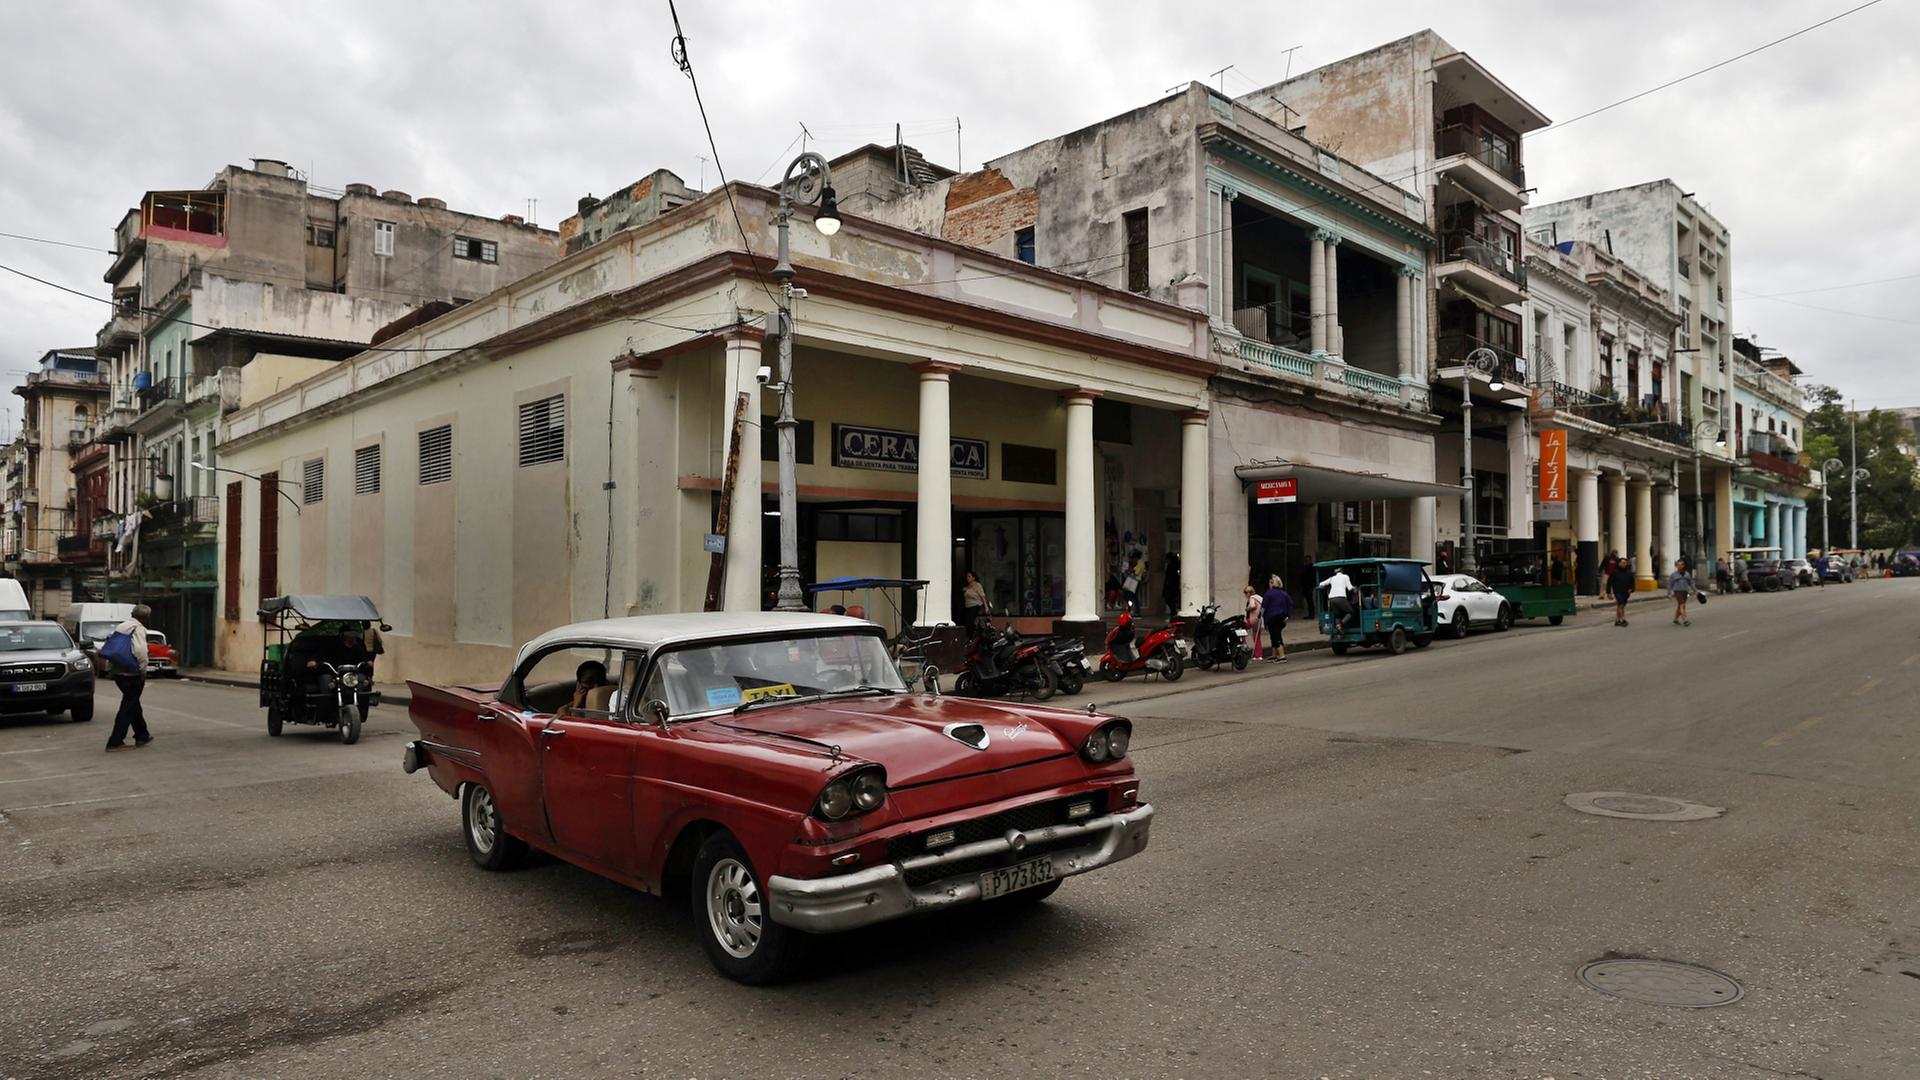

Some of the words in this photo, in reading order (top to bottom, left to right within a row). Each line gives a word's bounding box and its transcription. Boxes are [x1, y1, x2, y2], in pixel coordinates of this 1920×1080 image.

[844, 432, 983, 467] CERACA
[2, 667, 56, 675] MAXUS
[750, 688, 790, 700] TAXI
